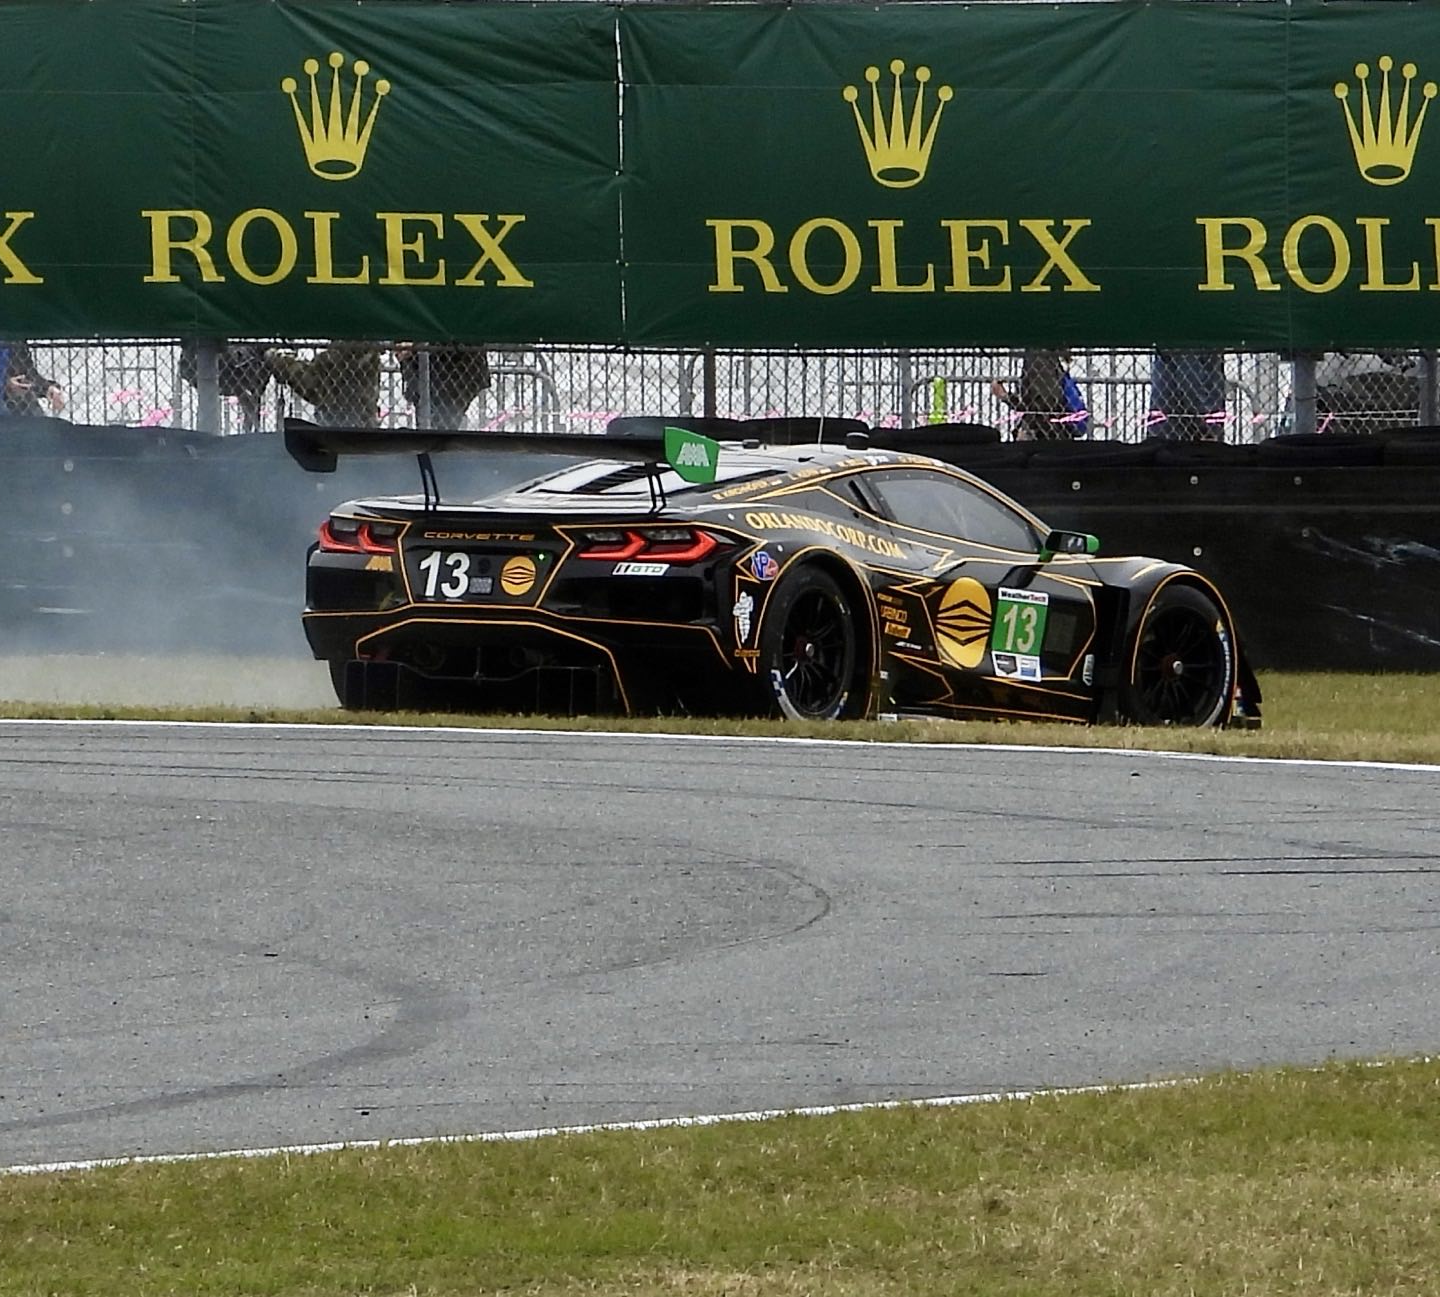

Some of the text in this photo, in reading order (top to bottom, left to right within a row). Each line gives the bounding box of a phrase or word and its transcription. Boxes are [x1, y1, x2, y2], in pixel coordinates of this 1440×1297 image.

[142, 208, 535, 287] ROLEX
[706, 217, 1100, 295] ROLEX
[1196, 215, 1440, 293] ROL
[423, 531, 536, 541] CORVETTE
[745, 512, 907, 560] ORLANDOCORP.COM
[420, 551, 470, 598] 13
[631, 565, 664, 573] GTD
[1003, 604, 1037, 653] 13
